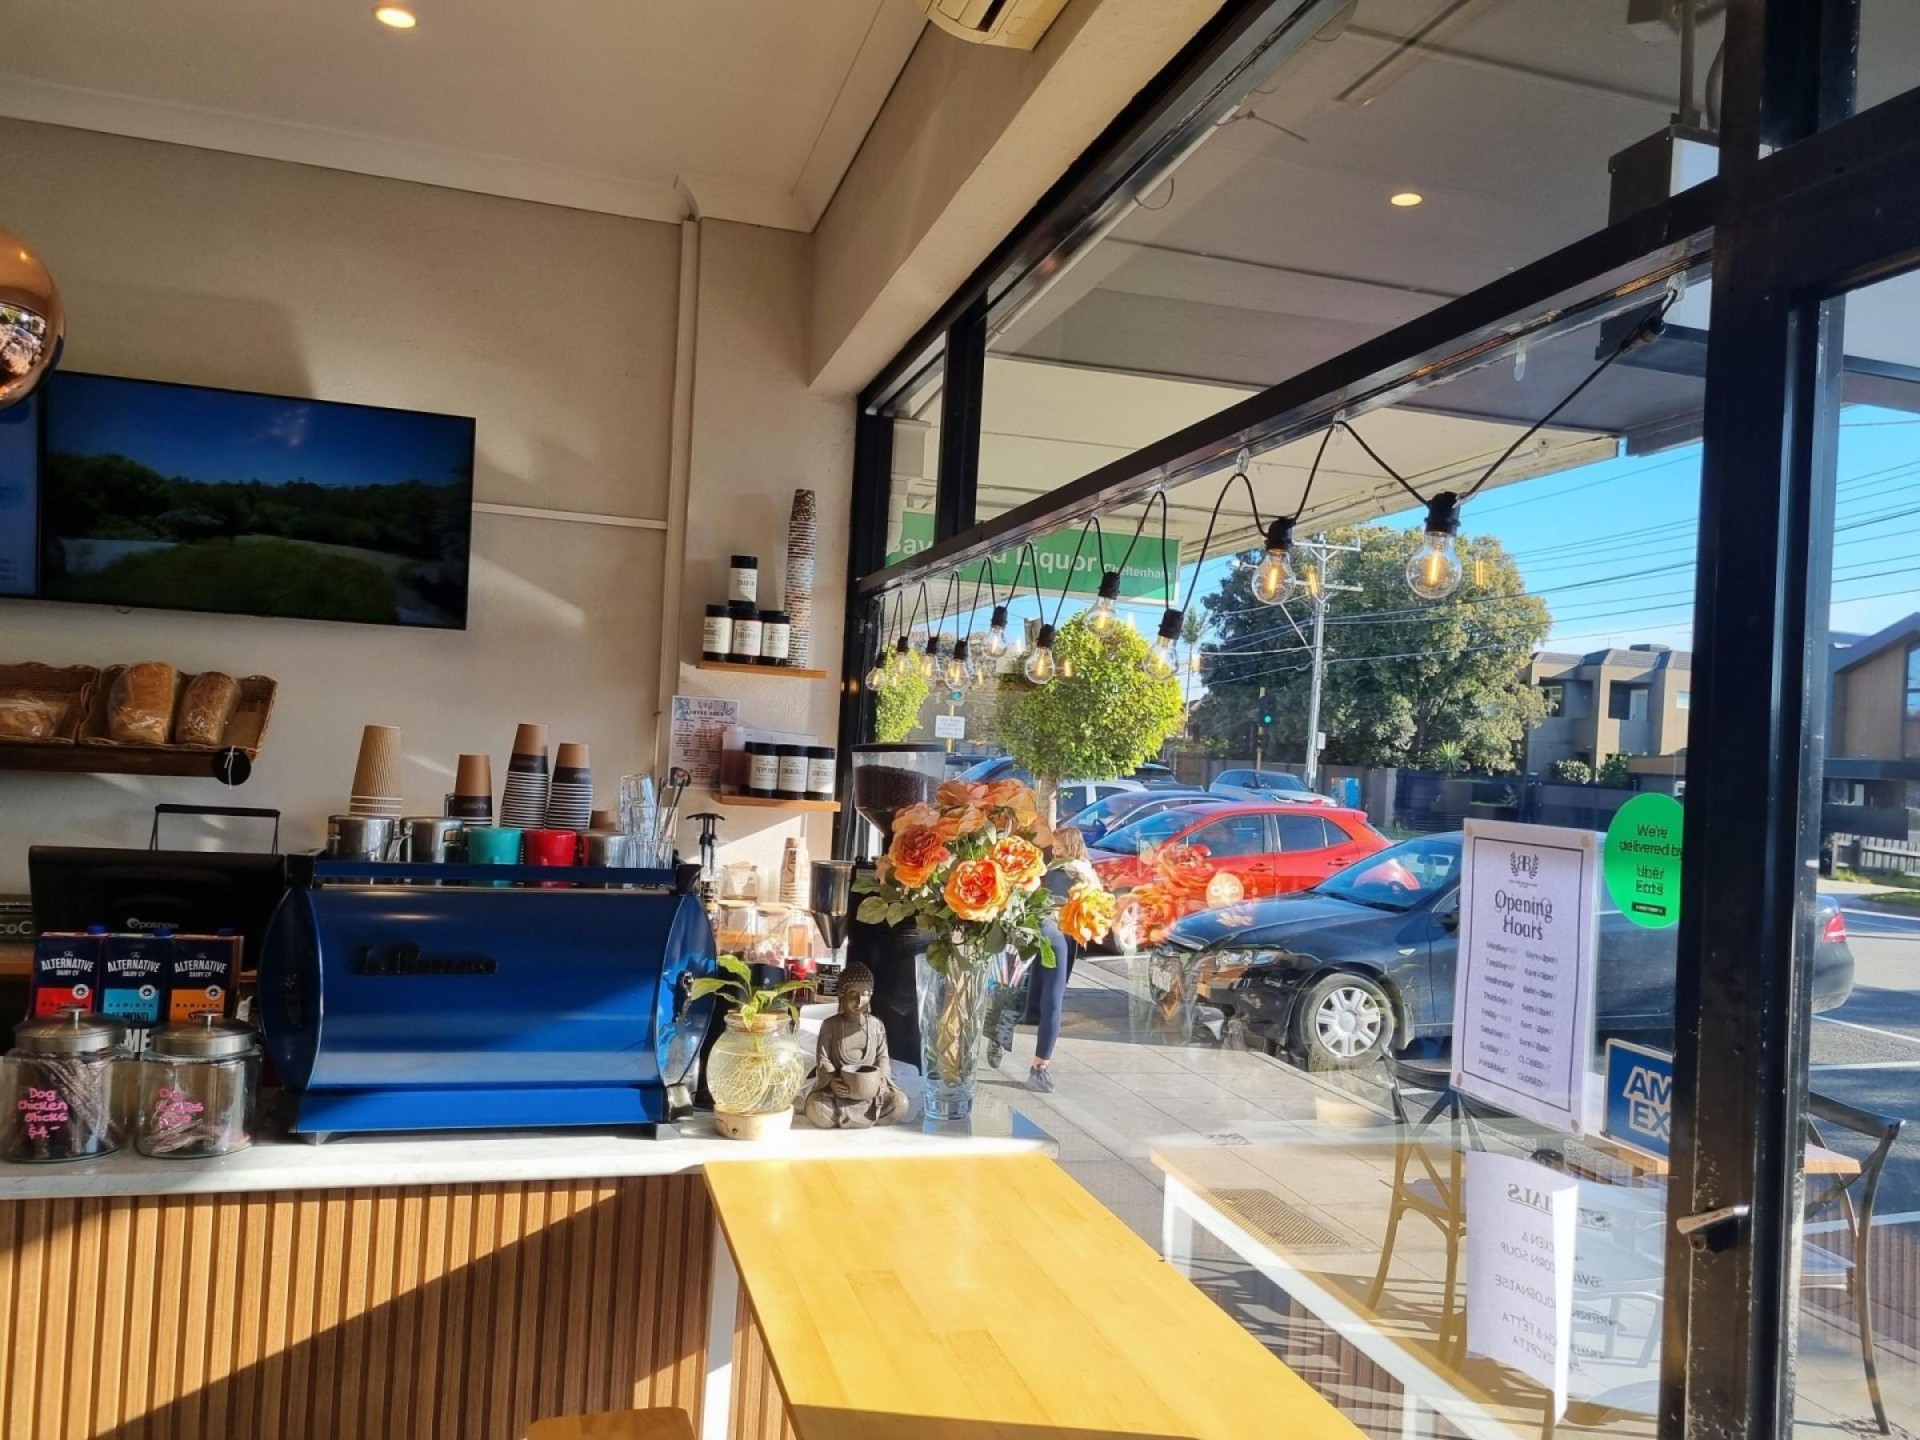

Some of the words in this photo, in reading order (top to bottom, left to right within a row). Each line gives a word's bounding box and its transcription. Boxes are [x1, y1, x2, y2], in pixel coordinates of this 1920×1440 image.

[1015, 546, 1097, 574] Liquor
[1103, 563, 1172, 579] Cheltenham
[1637, 823, 1668, 839] We're
[1619, 839, 1669, 857] delivered
[1636, 864, 1665, 880] Uber
[1636, 880, 1664, 896] Eats
[1495, 890, 1553, 924] Opening
[1503, 915, 1544, 941] Hours
[41, 957, 96, 974] ALTERNATIVE
[107, 958, 161, 974] ALTERNATIVE
[174, 959, 228, 975] ALTERNATIVE
[28, 1087, 57, 1101] Dog
